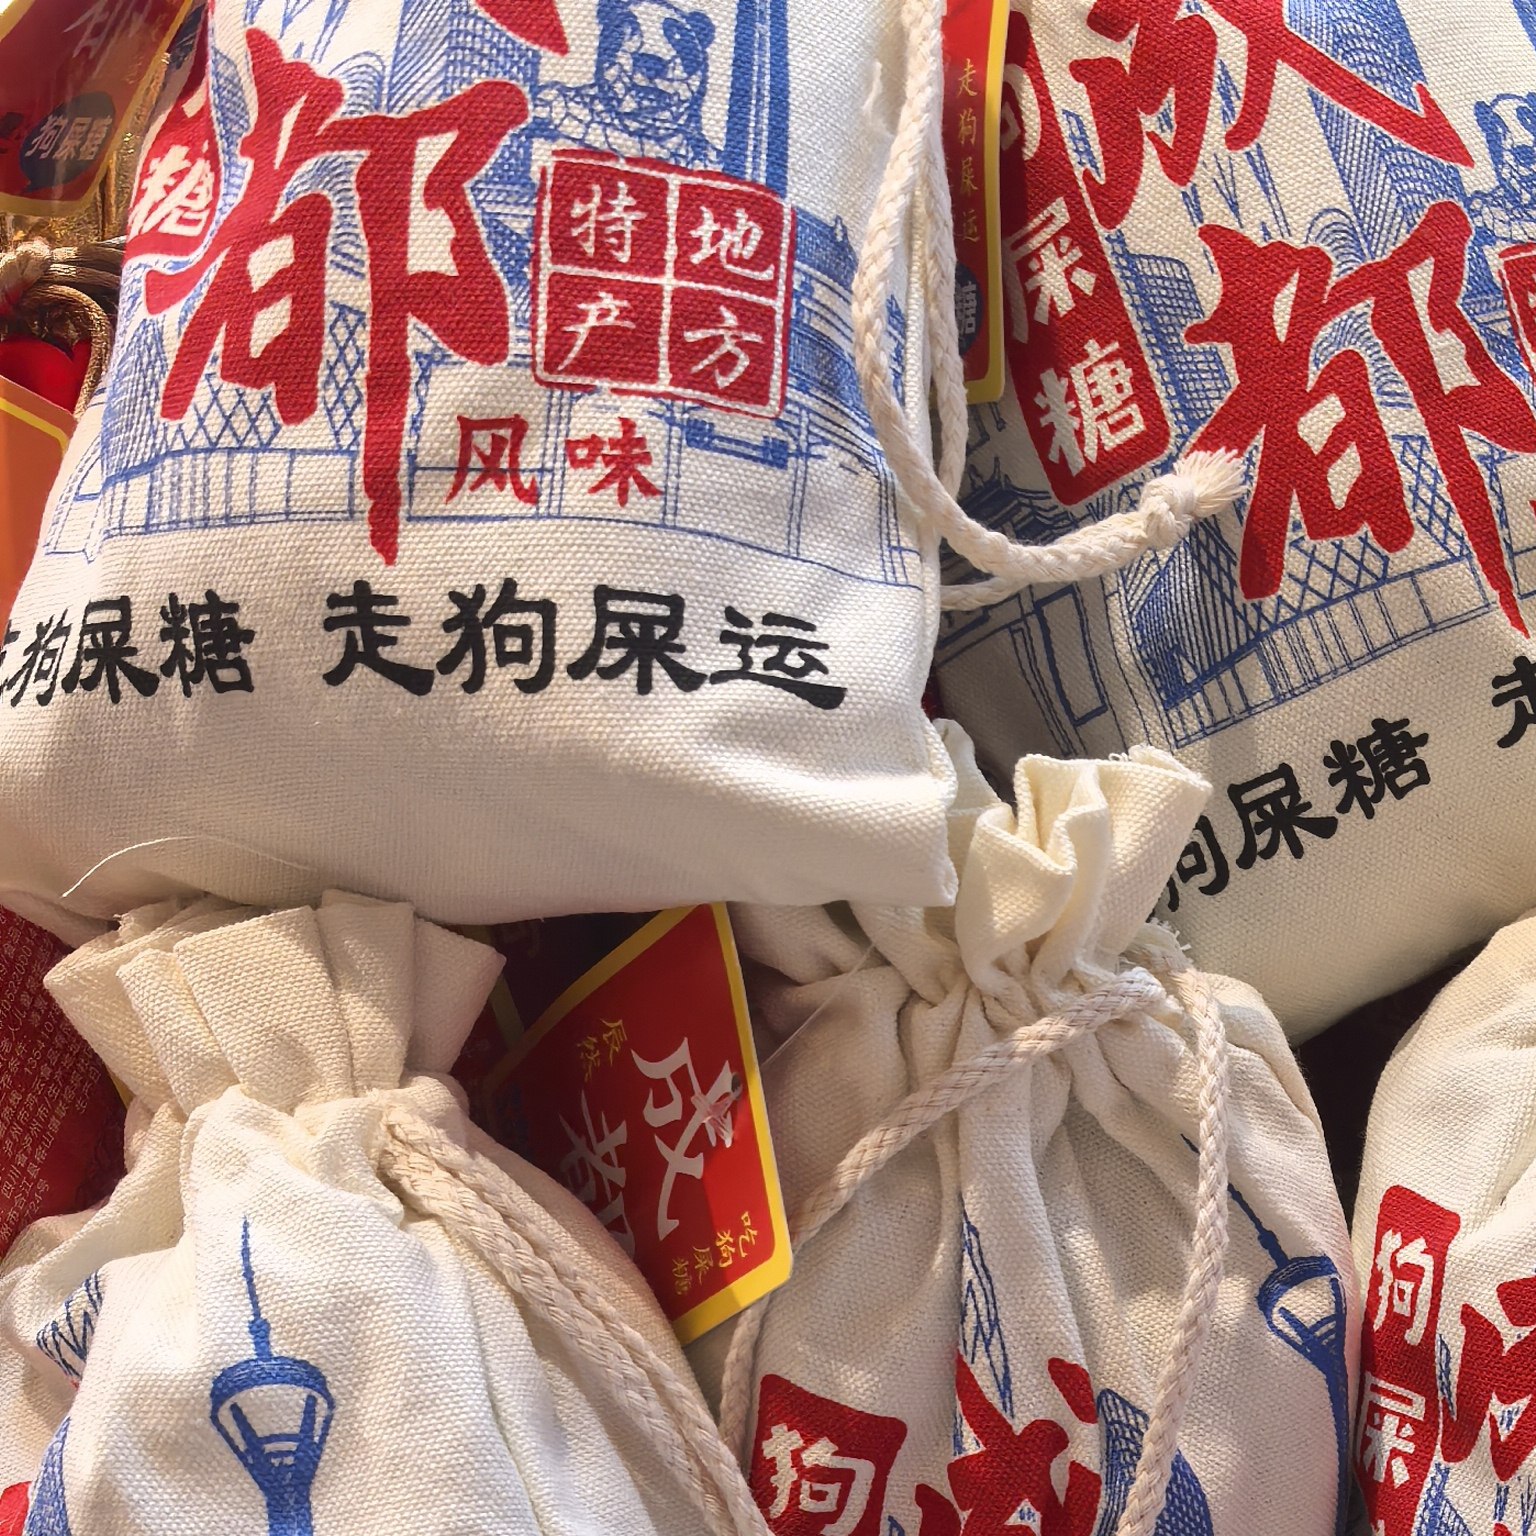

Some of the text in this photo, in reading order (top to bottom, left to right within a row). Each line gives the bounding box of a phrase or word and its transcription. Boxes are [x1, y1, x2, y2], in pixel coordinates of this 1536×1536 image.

[146, 0, 568, 565] 都
[446, 414, 663, 508] 风味
[0, 590, 255, 707] 狗屎糖
[322, 578, 846, 711] 走狗屎运
